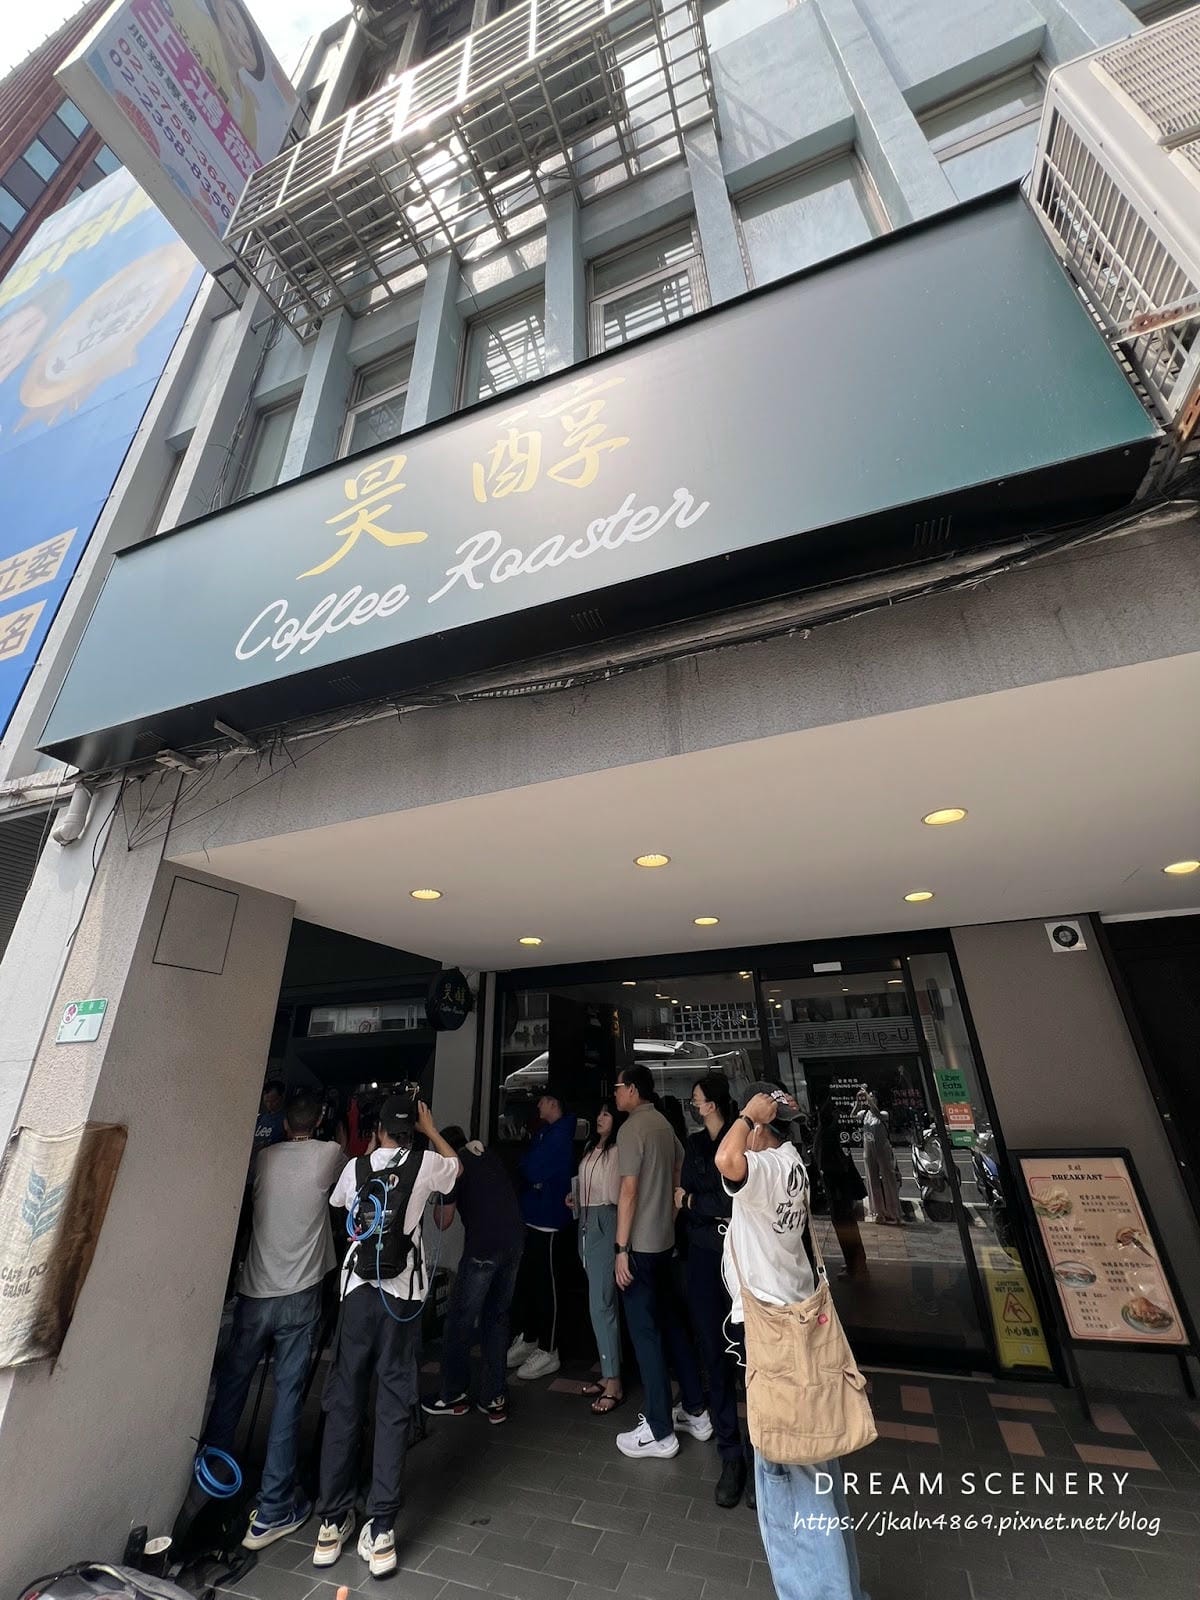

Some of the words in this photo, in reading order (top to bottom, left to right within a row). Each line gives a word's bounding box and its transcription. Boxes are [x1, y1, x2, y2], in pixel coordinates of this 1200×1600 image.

[109, 49, 231, 219] 02-2358-8356
[118, 37, 236, 206] 02-2756-3646
[235, 585, 410, 662] Coffee
[428, 487, 710, 604] Roaster
[74, 1018, 86, 1036] 7
[27, 1262, 49, 1280] DO
